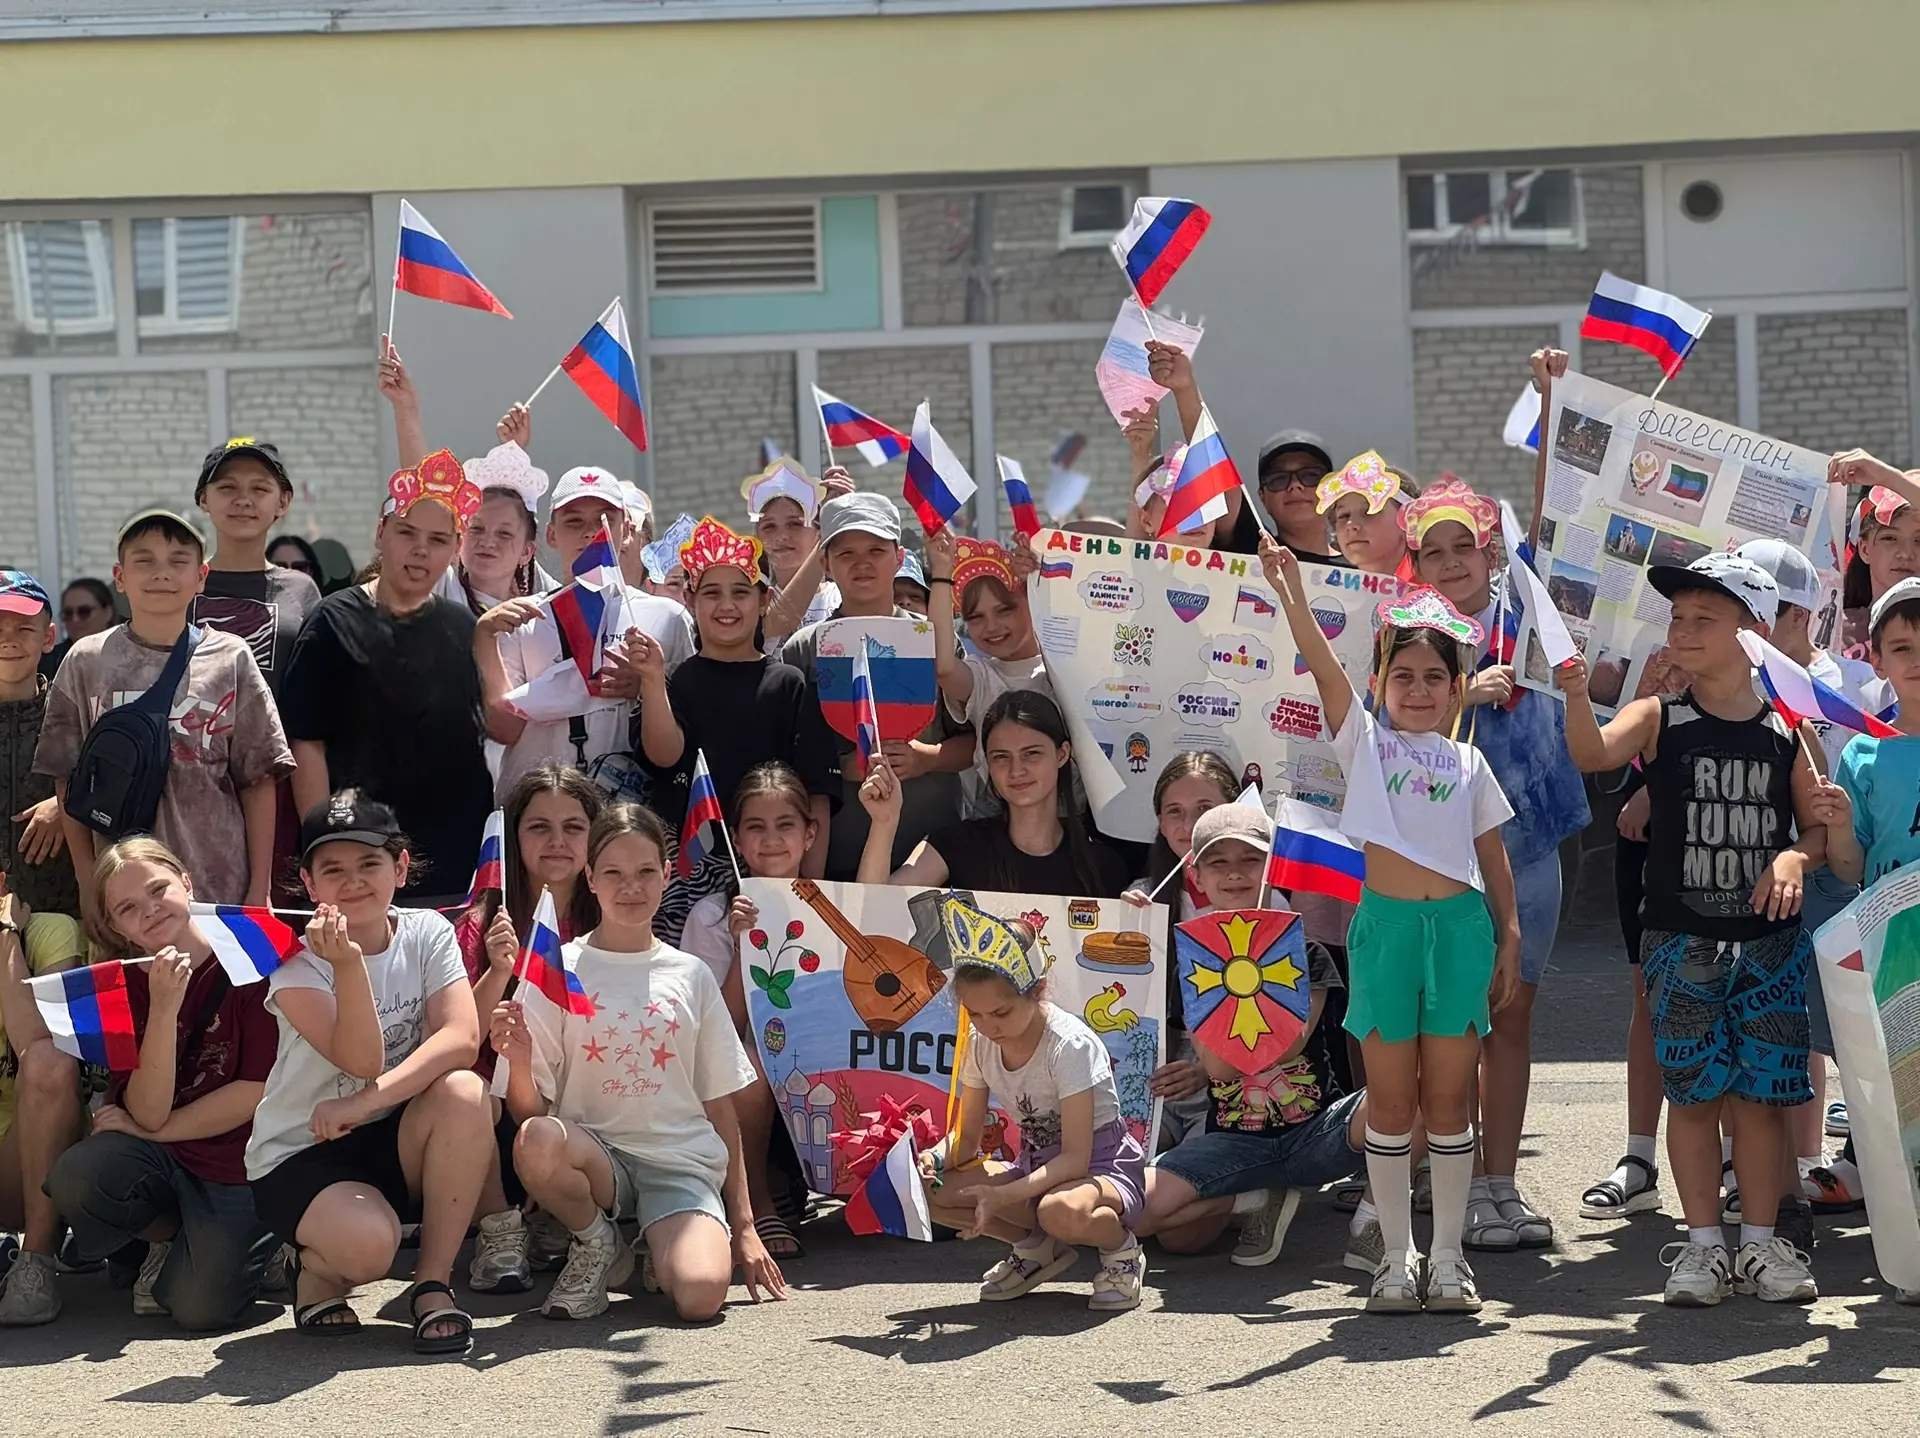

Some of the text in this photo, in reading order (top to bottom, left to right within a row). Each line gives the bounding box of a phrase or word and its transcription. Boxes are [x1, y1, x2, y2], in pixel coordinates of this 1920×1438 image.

[1638, 409, 1793, 471] Дагестан
[1047, 531, 1408, 597] ДЕНЬ НАРОДНО ЕДИНСТ
[1101, 575, 1122, 583] СИЛА
[1169, 591, 1207, 608] РОССИЯ
[1238, 645, 1247, 655] 4
[1212, 651, 1268, 670] НОЯБРЯ!
[1178, 694, 1228, 706] РОССИЯ
[1181, 704, 1236, 718] ЭТО МЫ!
[1694, 757, 1771, 803] RUN
[1686, 801, 1778, 847] JUMP
[1704, 890, 1744, 903] DON'
[1720, 904, 1753, 915] STO
[1747, 970, 1797, 1012] CROSS
[850, 1029, 957, 1075] РОСС
